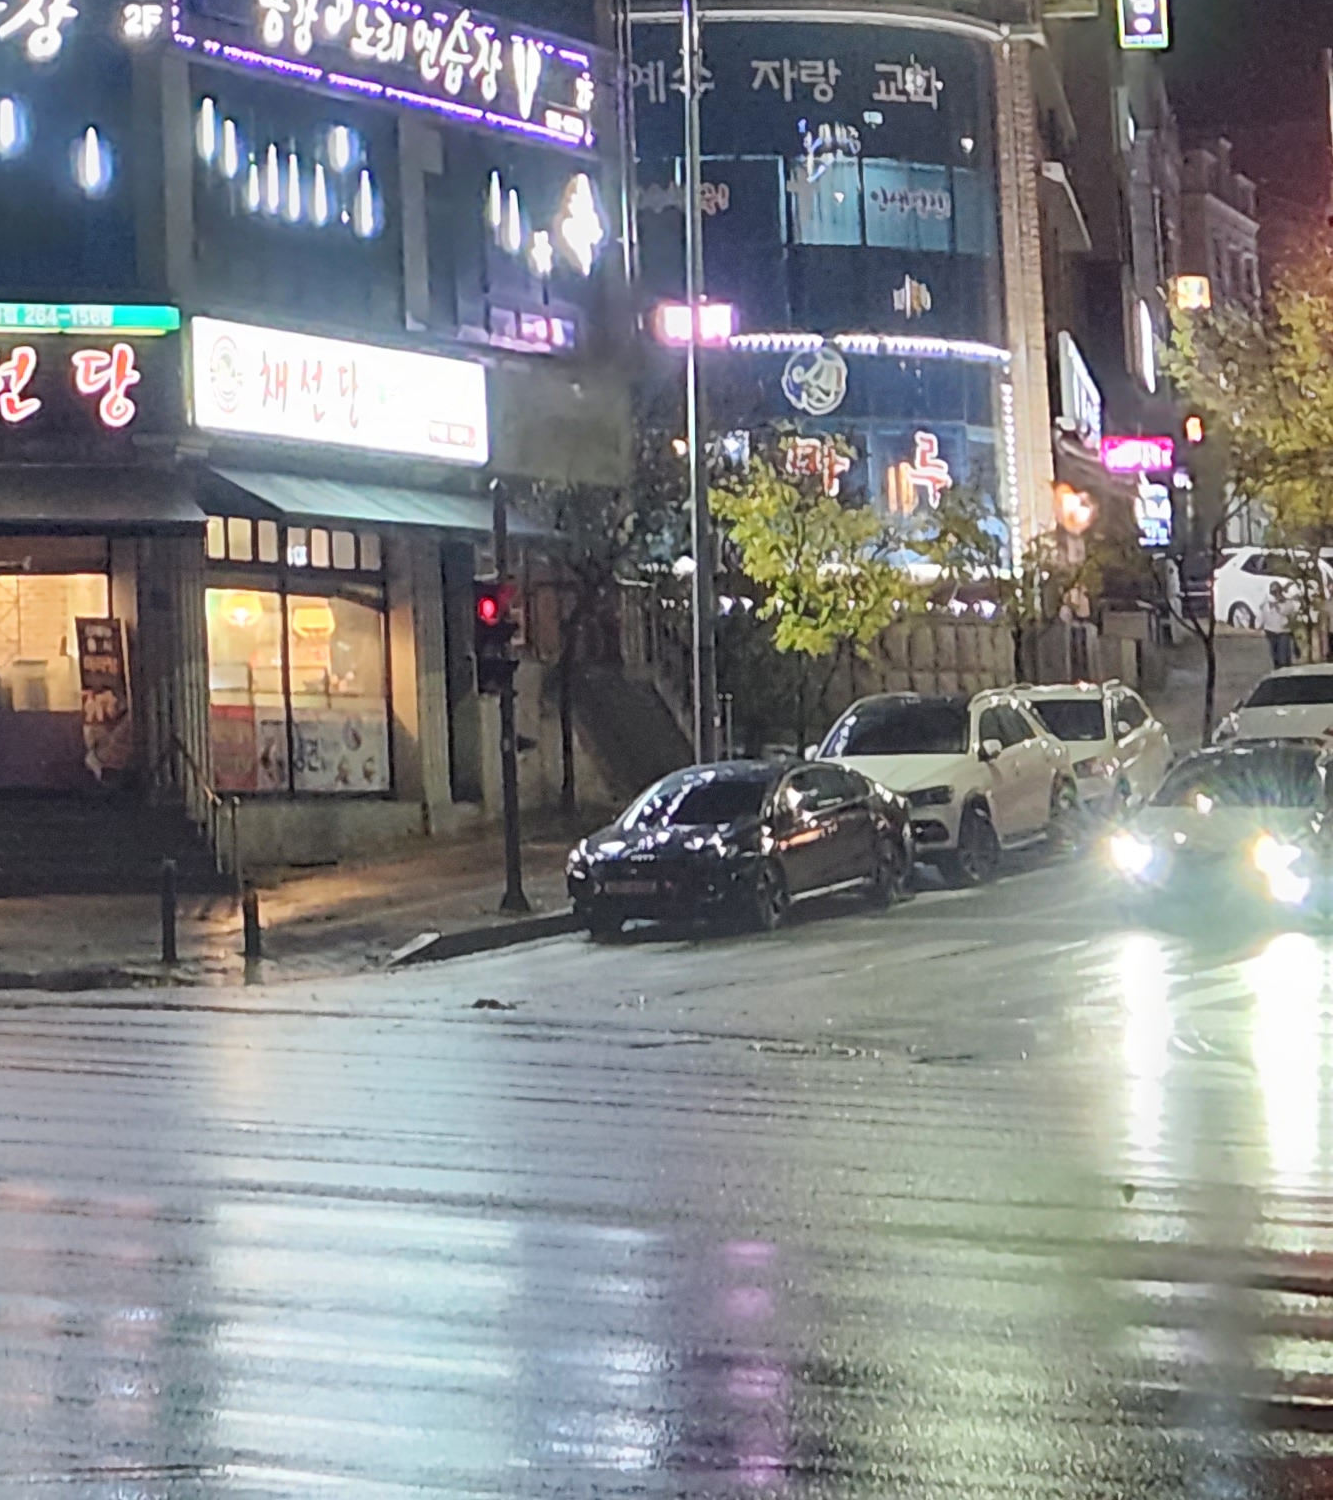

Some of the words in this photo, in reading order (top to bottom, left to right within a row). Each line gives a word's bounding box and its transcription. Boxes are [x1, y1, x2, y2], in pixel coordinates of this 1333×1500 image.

[123, 3, 162, 37] 2F
[751, 57, 841, 104] 자랑
[259, 350, 360, 429] 채선당
